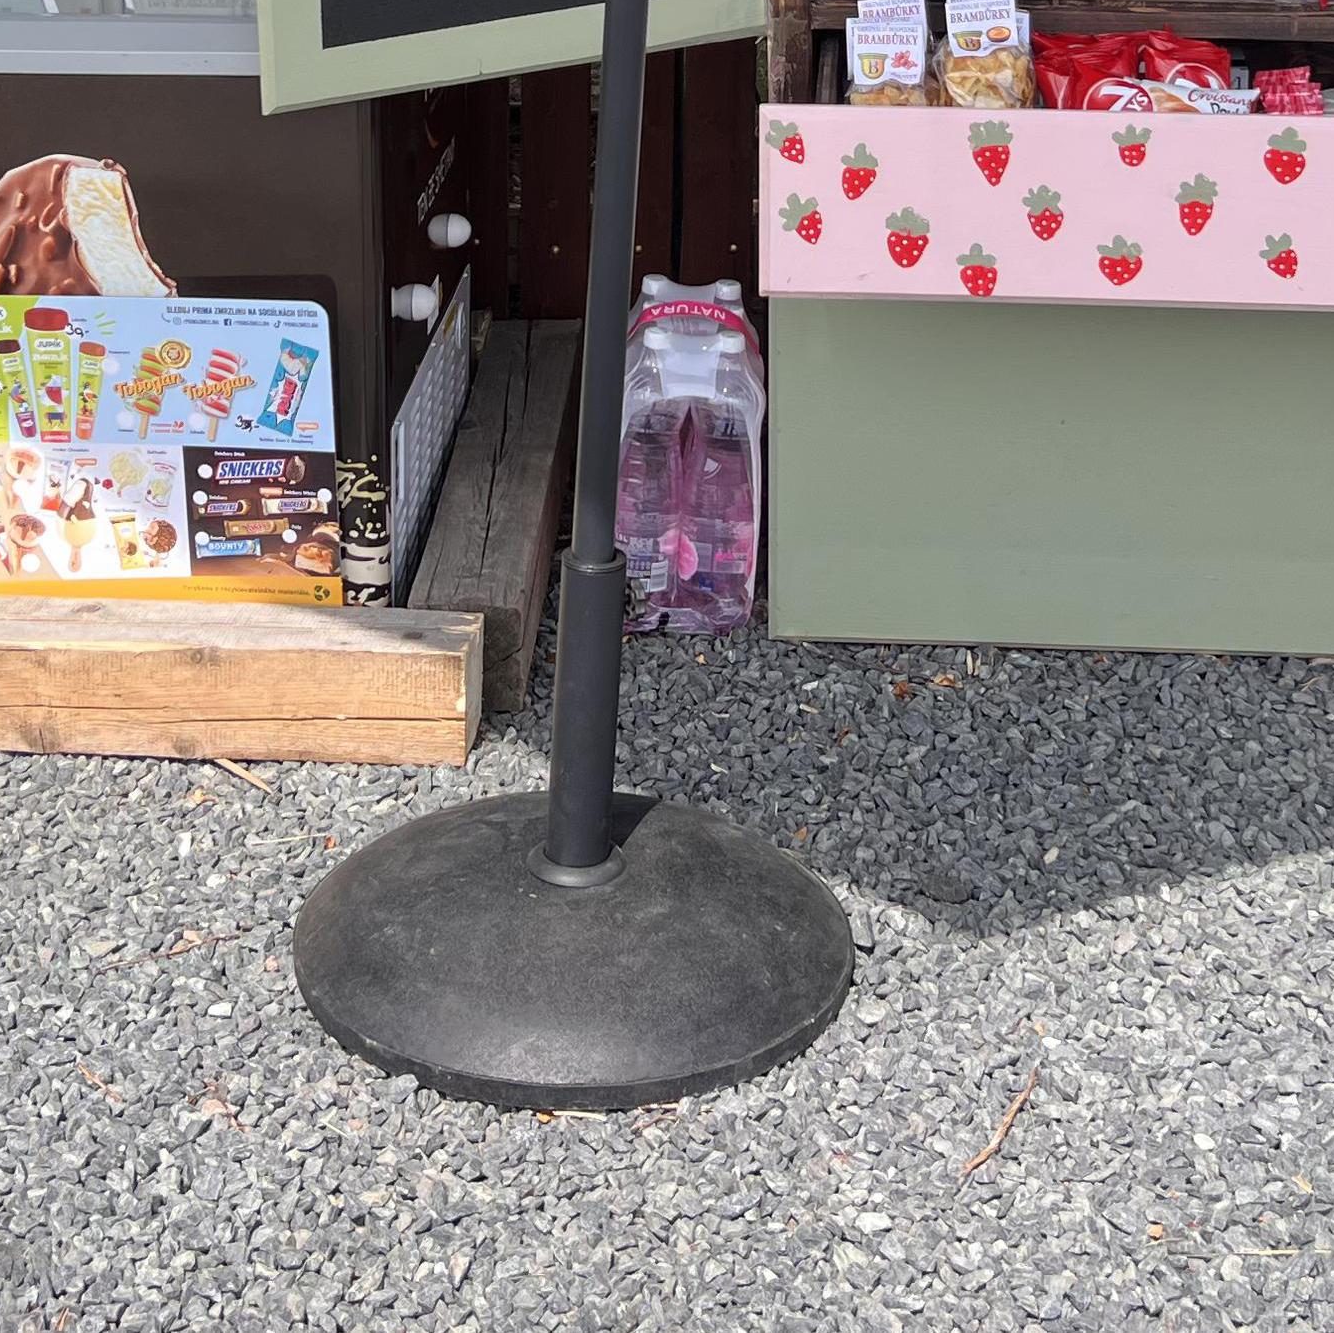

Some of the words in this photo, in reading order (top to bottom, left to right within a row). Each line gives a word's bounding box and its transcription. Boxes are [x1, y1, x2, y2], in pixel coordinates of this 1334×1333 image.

[1187, 88, 1253, 105] Croissan
[651, 304, 726, 320] NATURA
[219, 460, 283, 478] SNICKERS
[209, 503, 237, 511] SNICKERS
[209, 542, 244, 550] BOUNTY
